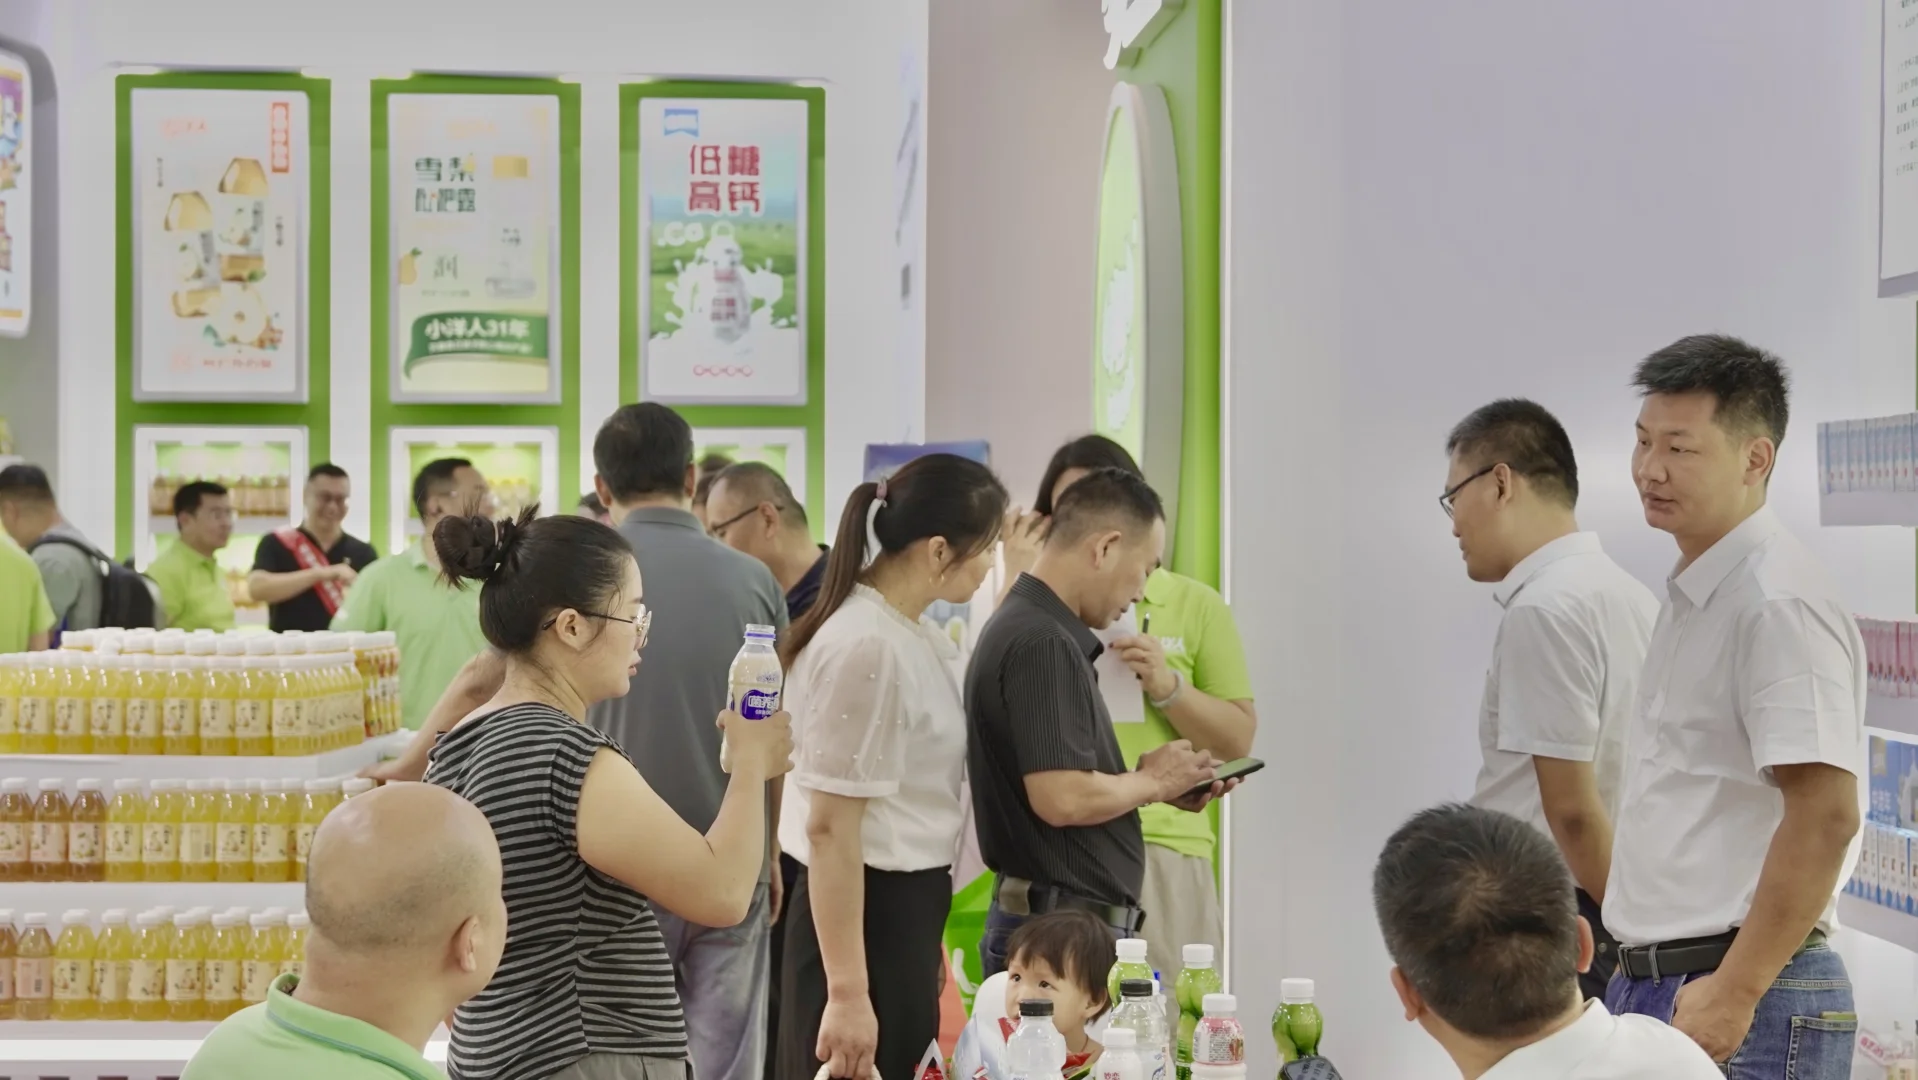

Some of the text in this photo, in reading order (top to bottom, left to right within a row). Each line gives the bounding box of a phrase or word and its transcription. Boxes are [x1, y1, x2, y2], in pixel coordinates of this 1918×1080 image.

[689, 144, 760, 175] 低糖
[689, 181, 760, 212] 高钙
[424, 316, 531, 341] 小洋人31年
